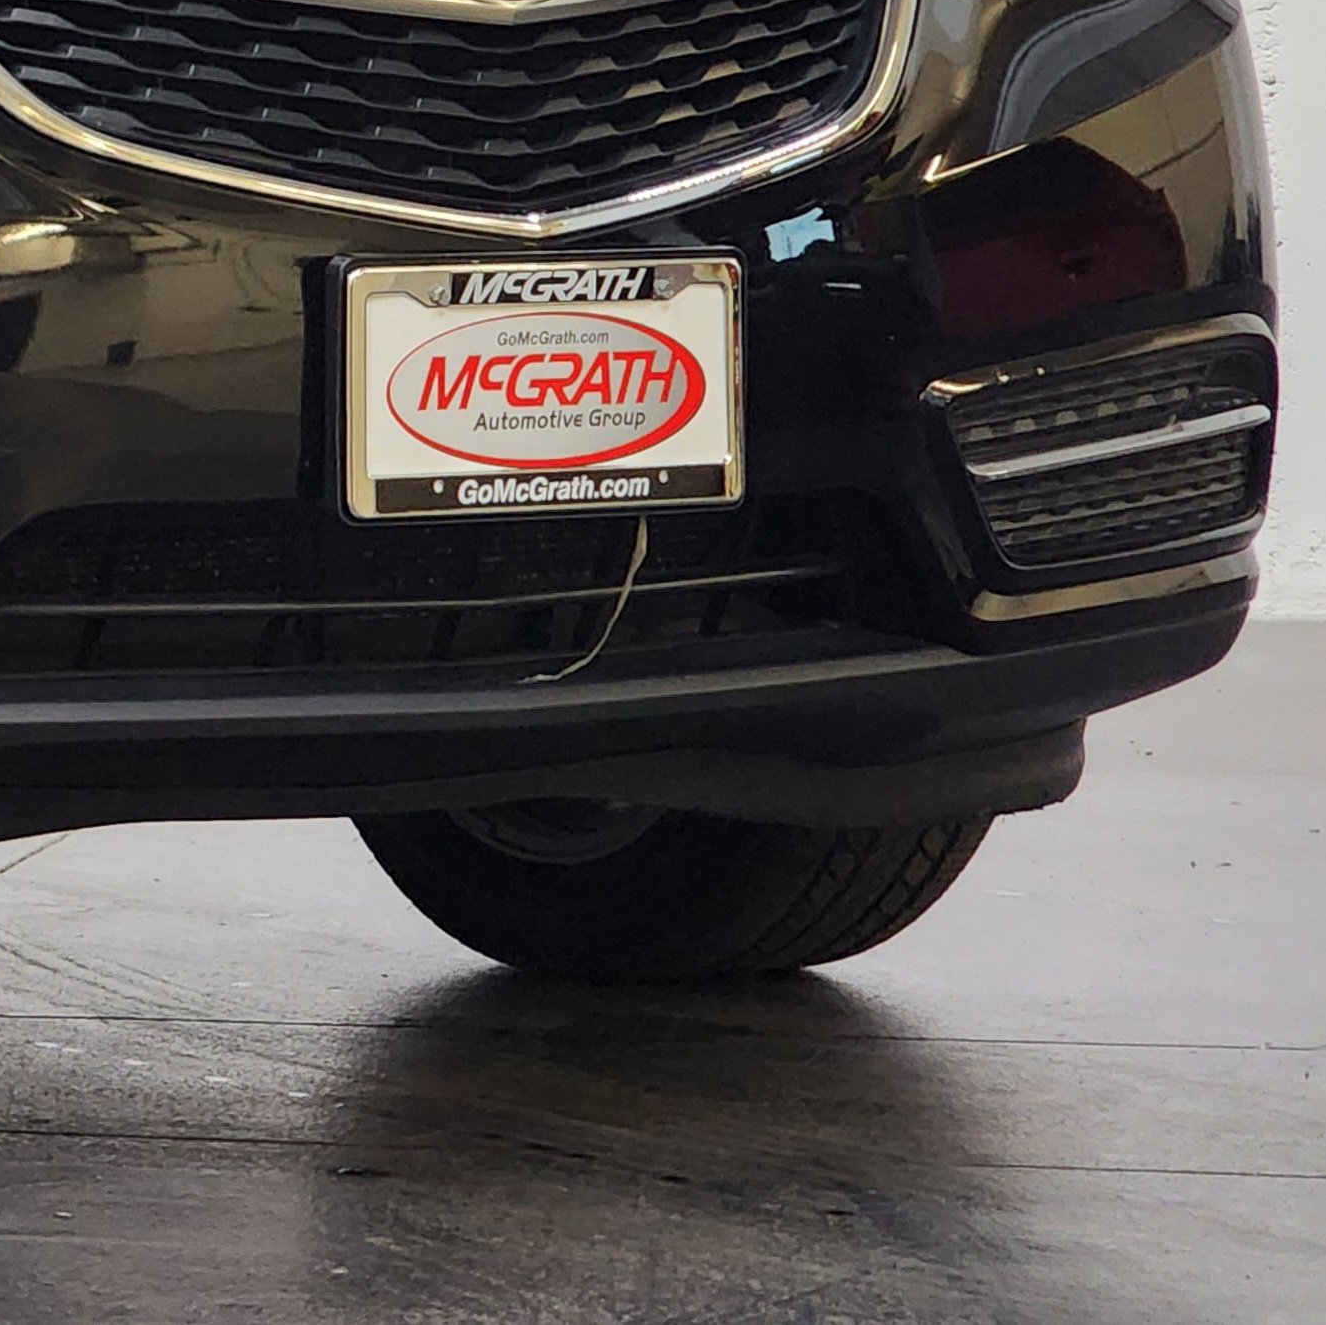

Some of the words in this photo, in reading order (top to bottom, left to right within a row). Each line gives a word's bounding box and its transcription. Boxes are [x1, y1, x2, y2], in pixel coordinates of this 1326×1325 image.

[496, 330, 609, 346] GoMcGrath.com
[472, 413, 583, 432] Automotive
[588, 409, 646, 431] Group
[457, 475, 650, 506] GoMcGrath.com
